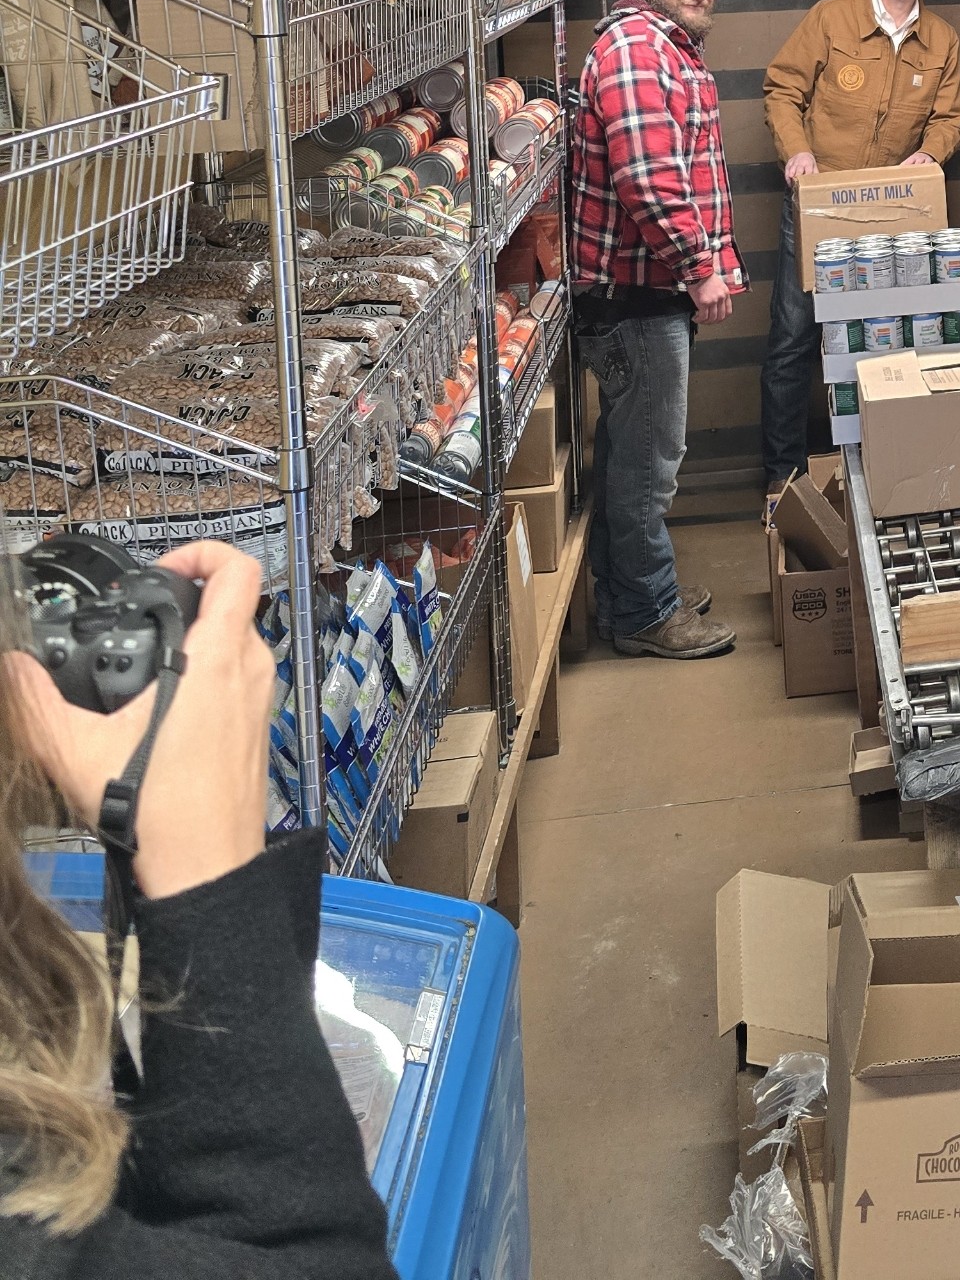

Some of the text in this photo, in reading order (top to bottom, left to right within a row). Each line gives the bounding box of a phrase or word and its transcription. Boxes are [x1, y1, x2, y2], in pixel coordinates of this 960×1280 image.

[832, 184, 914, 204] NON FAT MILK
[147, 522, 208, 537] PINTO
[210, 511, 273, 533] BEANS
[835, 587, 851, 598] SH
[897, 1209, 945, 1221] FRAGILE
